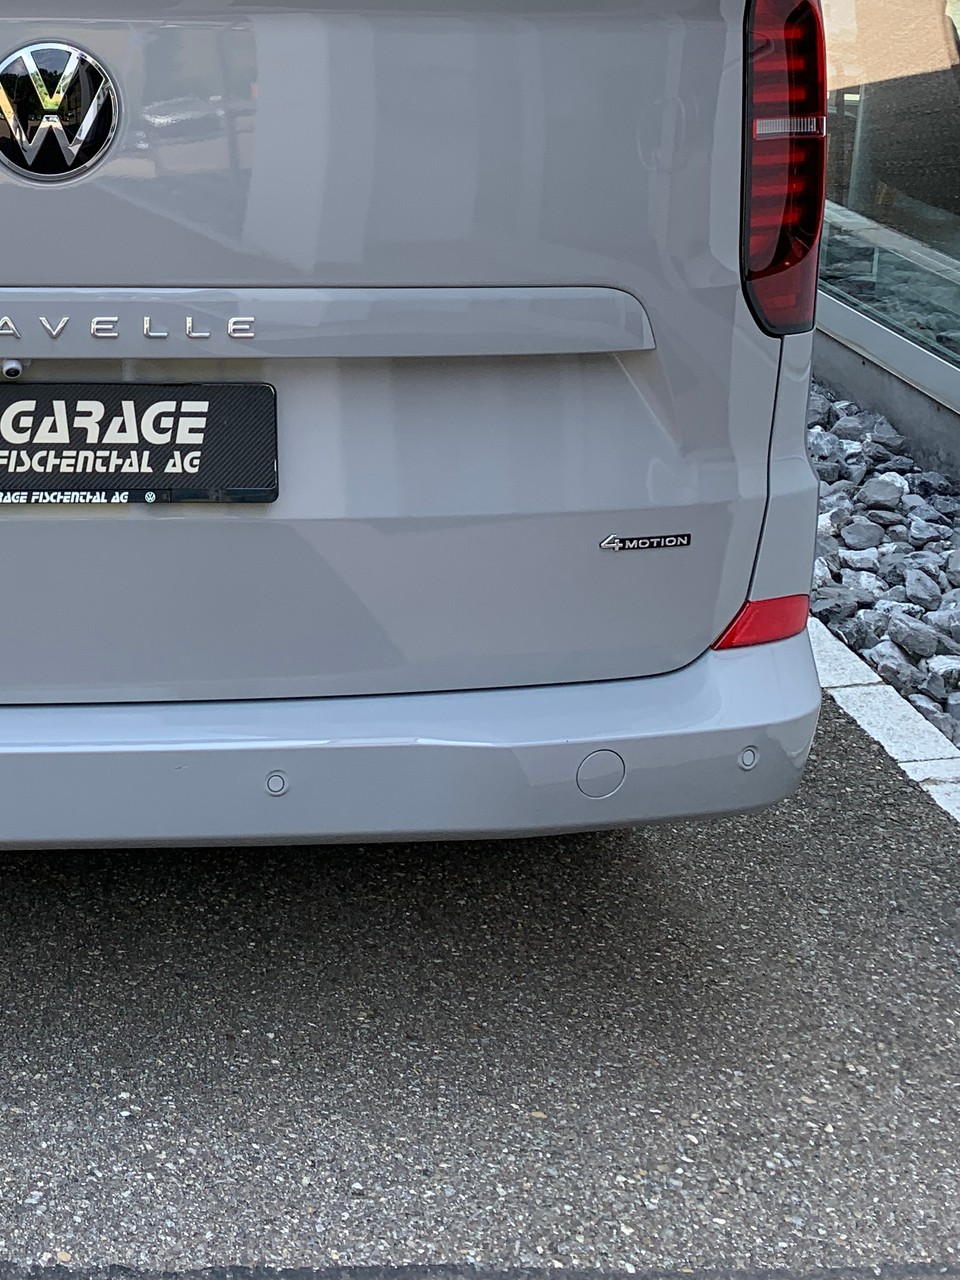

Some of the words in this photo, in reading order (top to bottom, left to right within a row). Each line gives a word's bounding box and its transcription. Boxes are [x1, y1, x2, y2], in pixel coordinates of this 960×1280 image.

[0, 400, 209, 444] GARAGE
[164, 450, 202, 473] AG
[31, 492, 107, 503] FISCHENTHAL
[111, 492, 129, 503] AG
